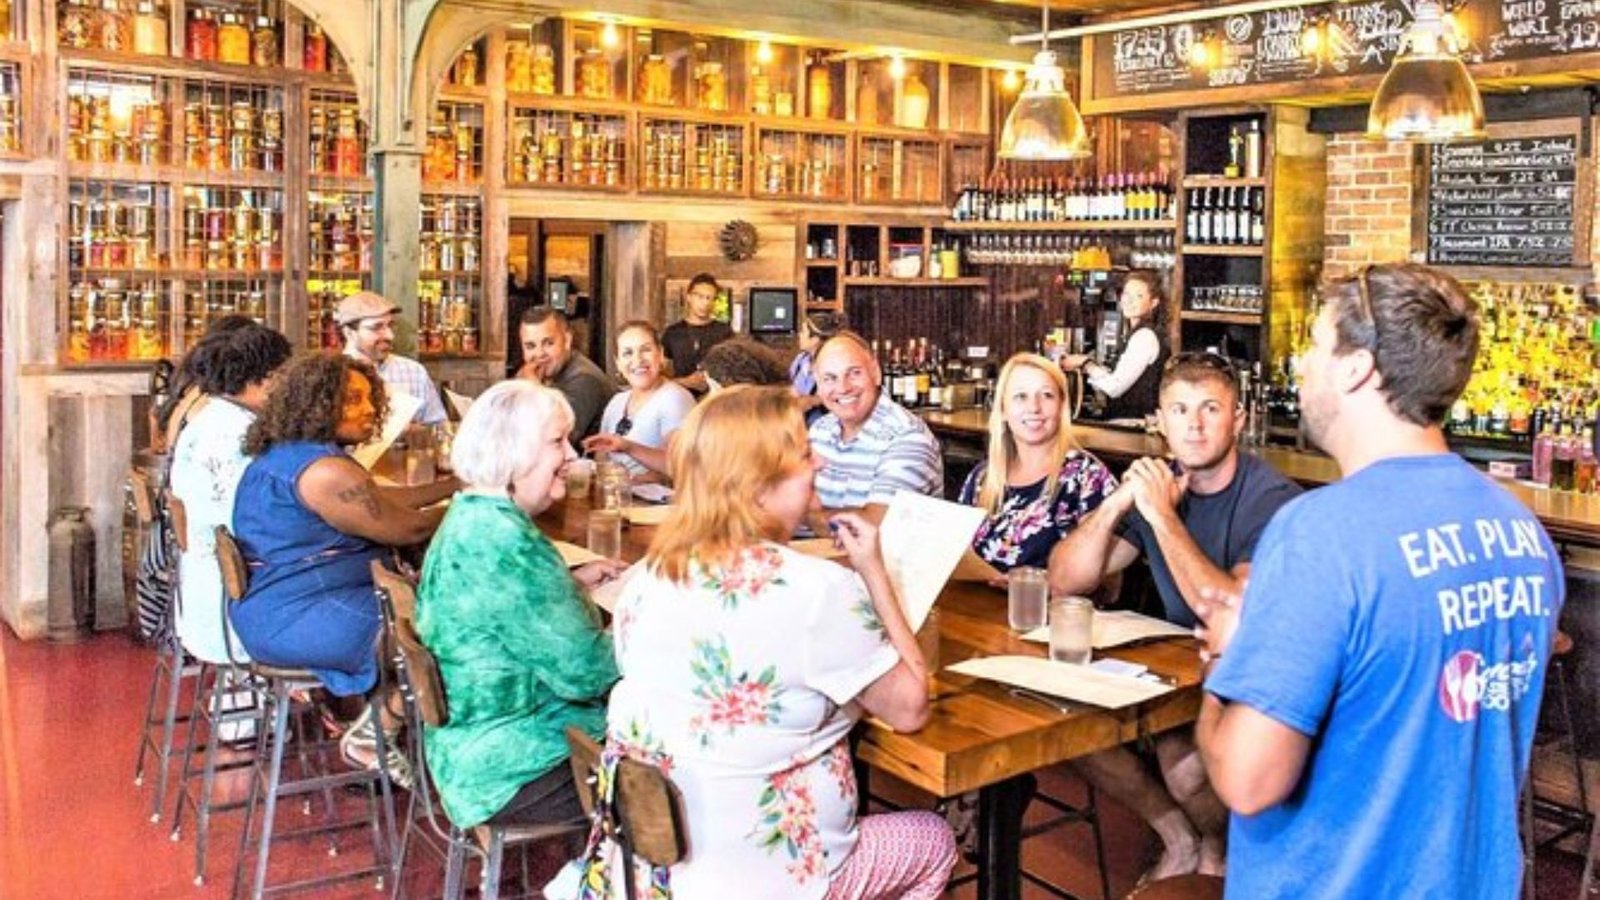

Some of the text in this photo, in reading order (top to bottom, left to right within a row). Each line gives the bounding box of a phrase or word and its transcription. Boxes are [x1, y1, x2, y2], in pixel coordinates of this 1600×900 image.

[1502, 0, 1546, 21] WORLD
[1399, 523, 1476, 577] EAT.
[1437, 575, 1549, 635] REPEAT.
